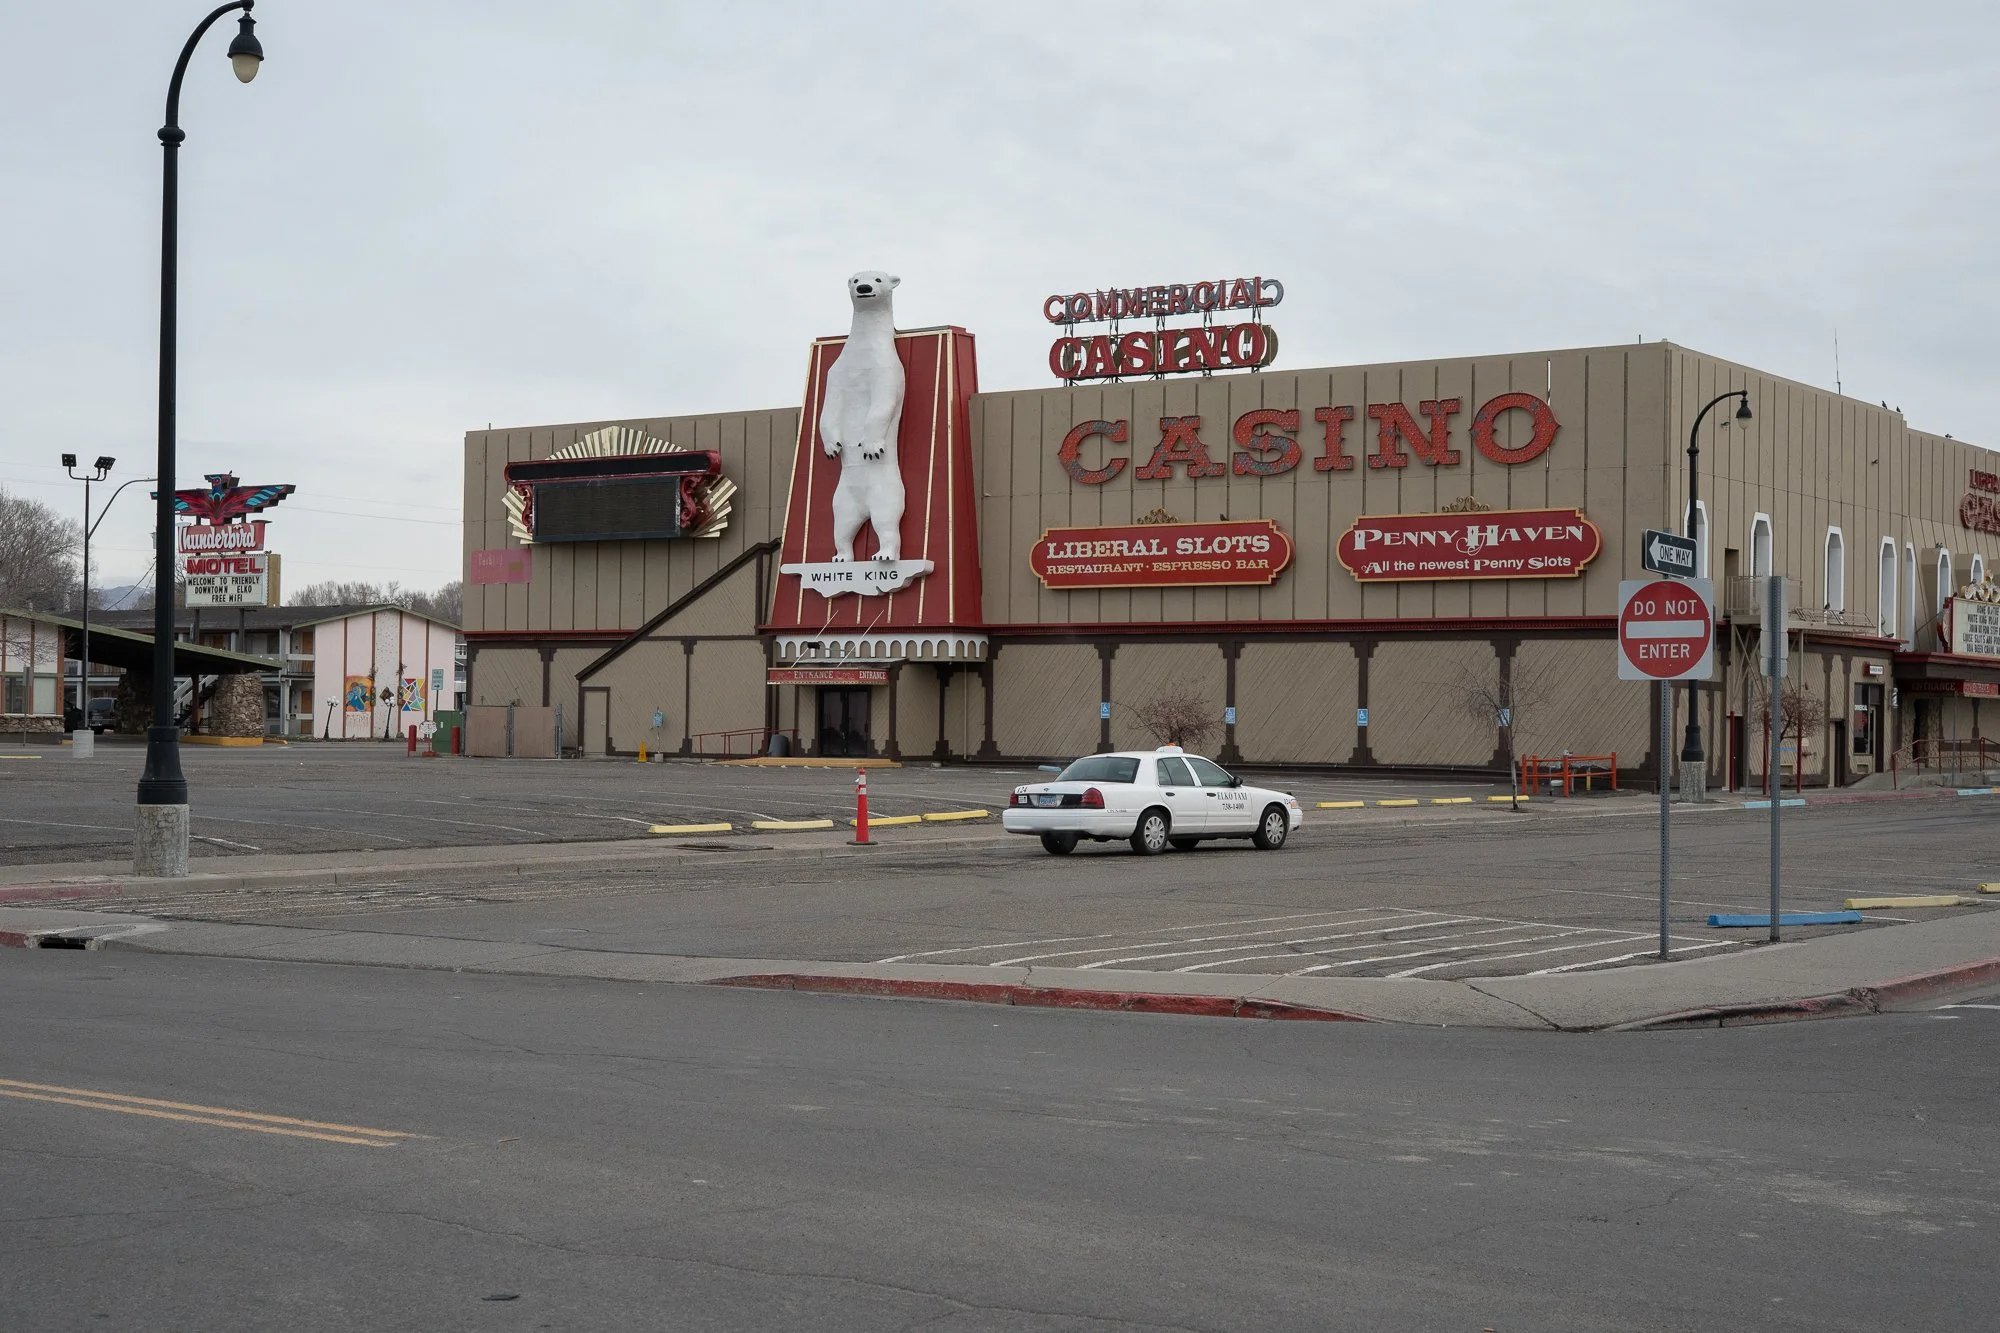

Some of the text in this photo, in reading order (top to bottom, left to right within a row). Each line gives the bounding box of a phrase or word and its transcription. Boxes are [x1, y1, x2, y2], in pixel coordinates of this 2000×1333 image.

[1043, 276, 1274, 322] COMMERCIAL
[1049, 323, 1265, 378] CASINO
[1057, 392, 1561, 484] CASINO
[176, 522, 256, 551] Thunderbird
[1353, 525, 1583, 555] PENNY HAVEN
[1047, 535, 1270, 559] LIBERAL SLOTS
[1660, 545, 1690, 566] ONE WAY
[187, 558, 264, 575] MOTEL
[1046, 559, 1269, 575] RESTAURANT ESPRESSO BAR
[1361, 555, 1571, 574] All the newest Penny Slots
[188, 576, 260, 586] WELCOME TO FRIENDLY
[811, 570, 898, 582] WHITE KING
[237, 585, 252, 594] ELKO
[212, 594, 226, 603] FREE
[1634, 600, 1697, 616] DO NOT
[1639, 643, 1690, 659] ENTER
[794, 670, 833, 679] ENTRANCE
[859, 670, 886, 680] ENTRANCE
[1911, 681, 1956, 691] ENTRANCE
[1217, 792, 1248, 801] ELKO TAXI
